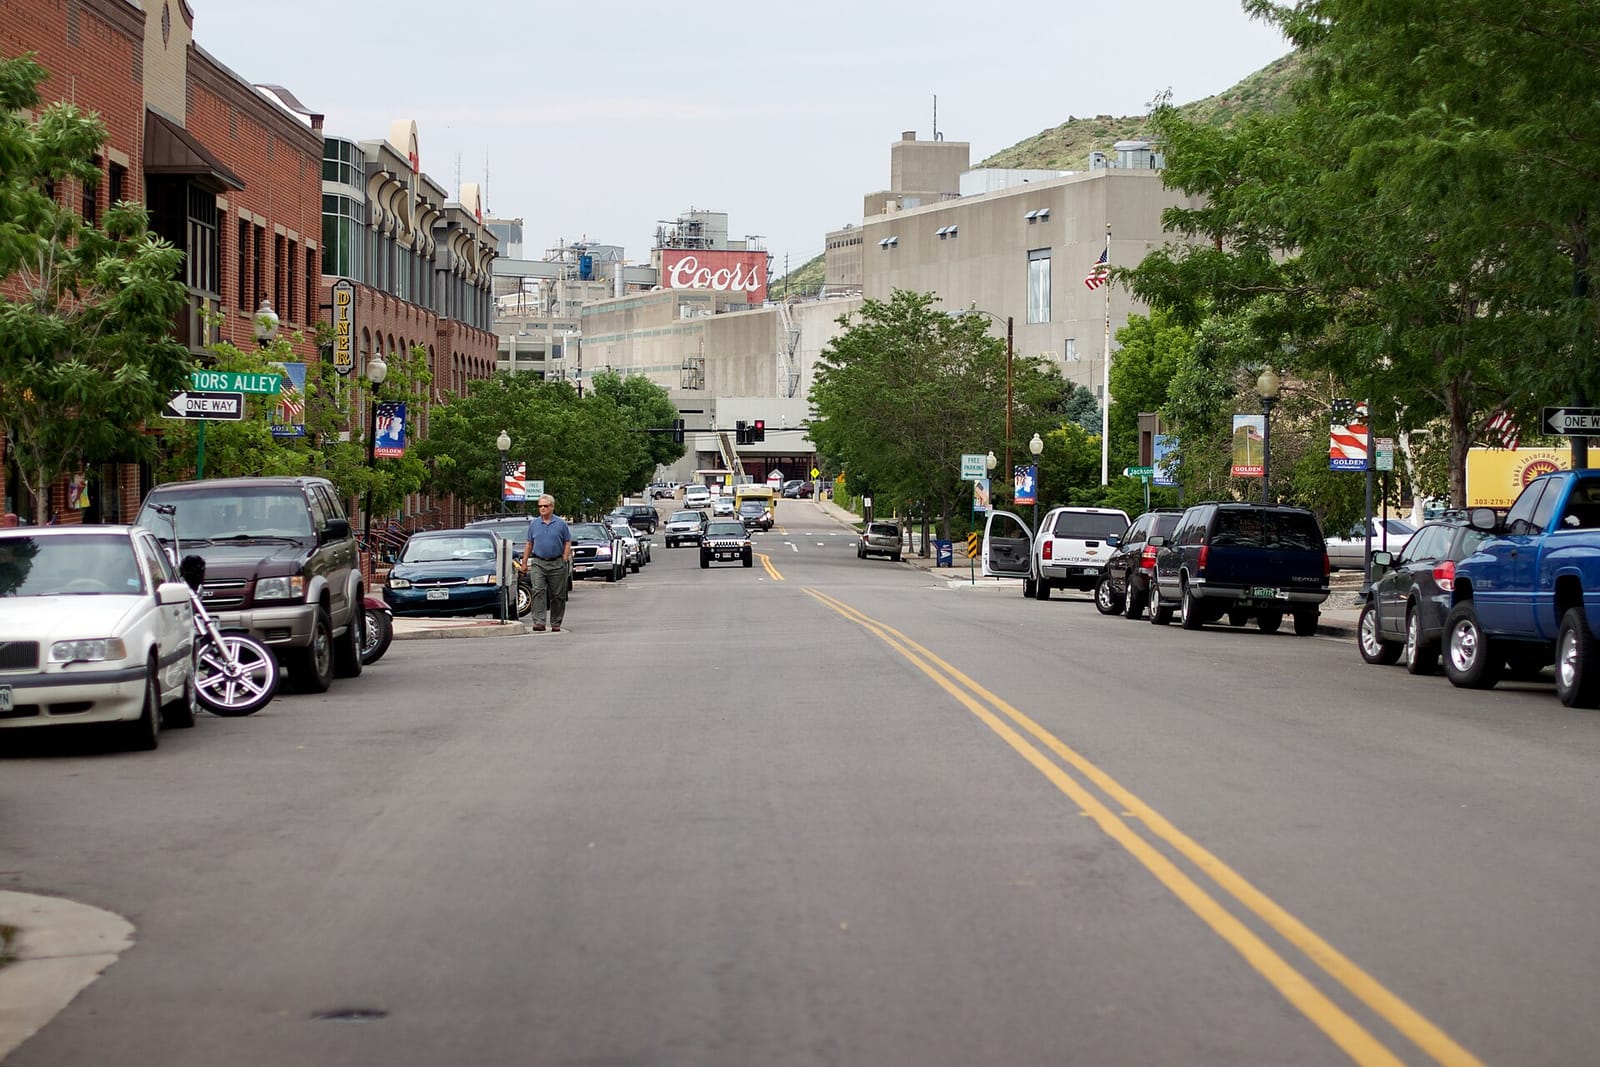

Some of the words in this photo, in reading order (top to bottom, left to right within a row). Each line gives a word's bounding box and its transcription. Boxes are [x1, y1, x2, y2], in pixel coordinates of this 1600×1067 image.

[667, 256, 761, 291] Coors
[335, 291, 351, 366] DINER
[234, 375, 278, 392] ALLEY
[186, 399, 208, 410] ONE
[212, 400, 234, 411] WAY
[1564, 416, 1586, 427] ONE
[1520, 453, 1559, 465] Insurance
